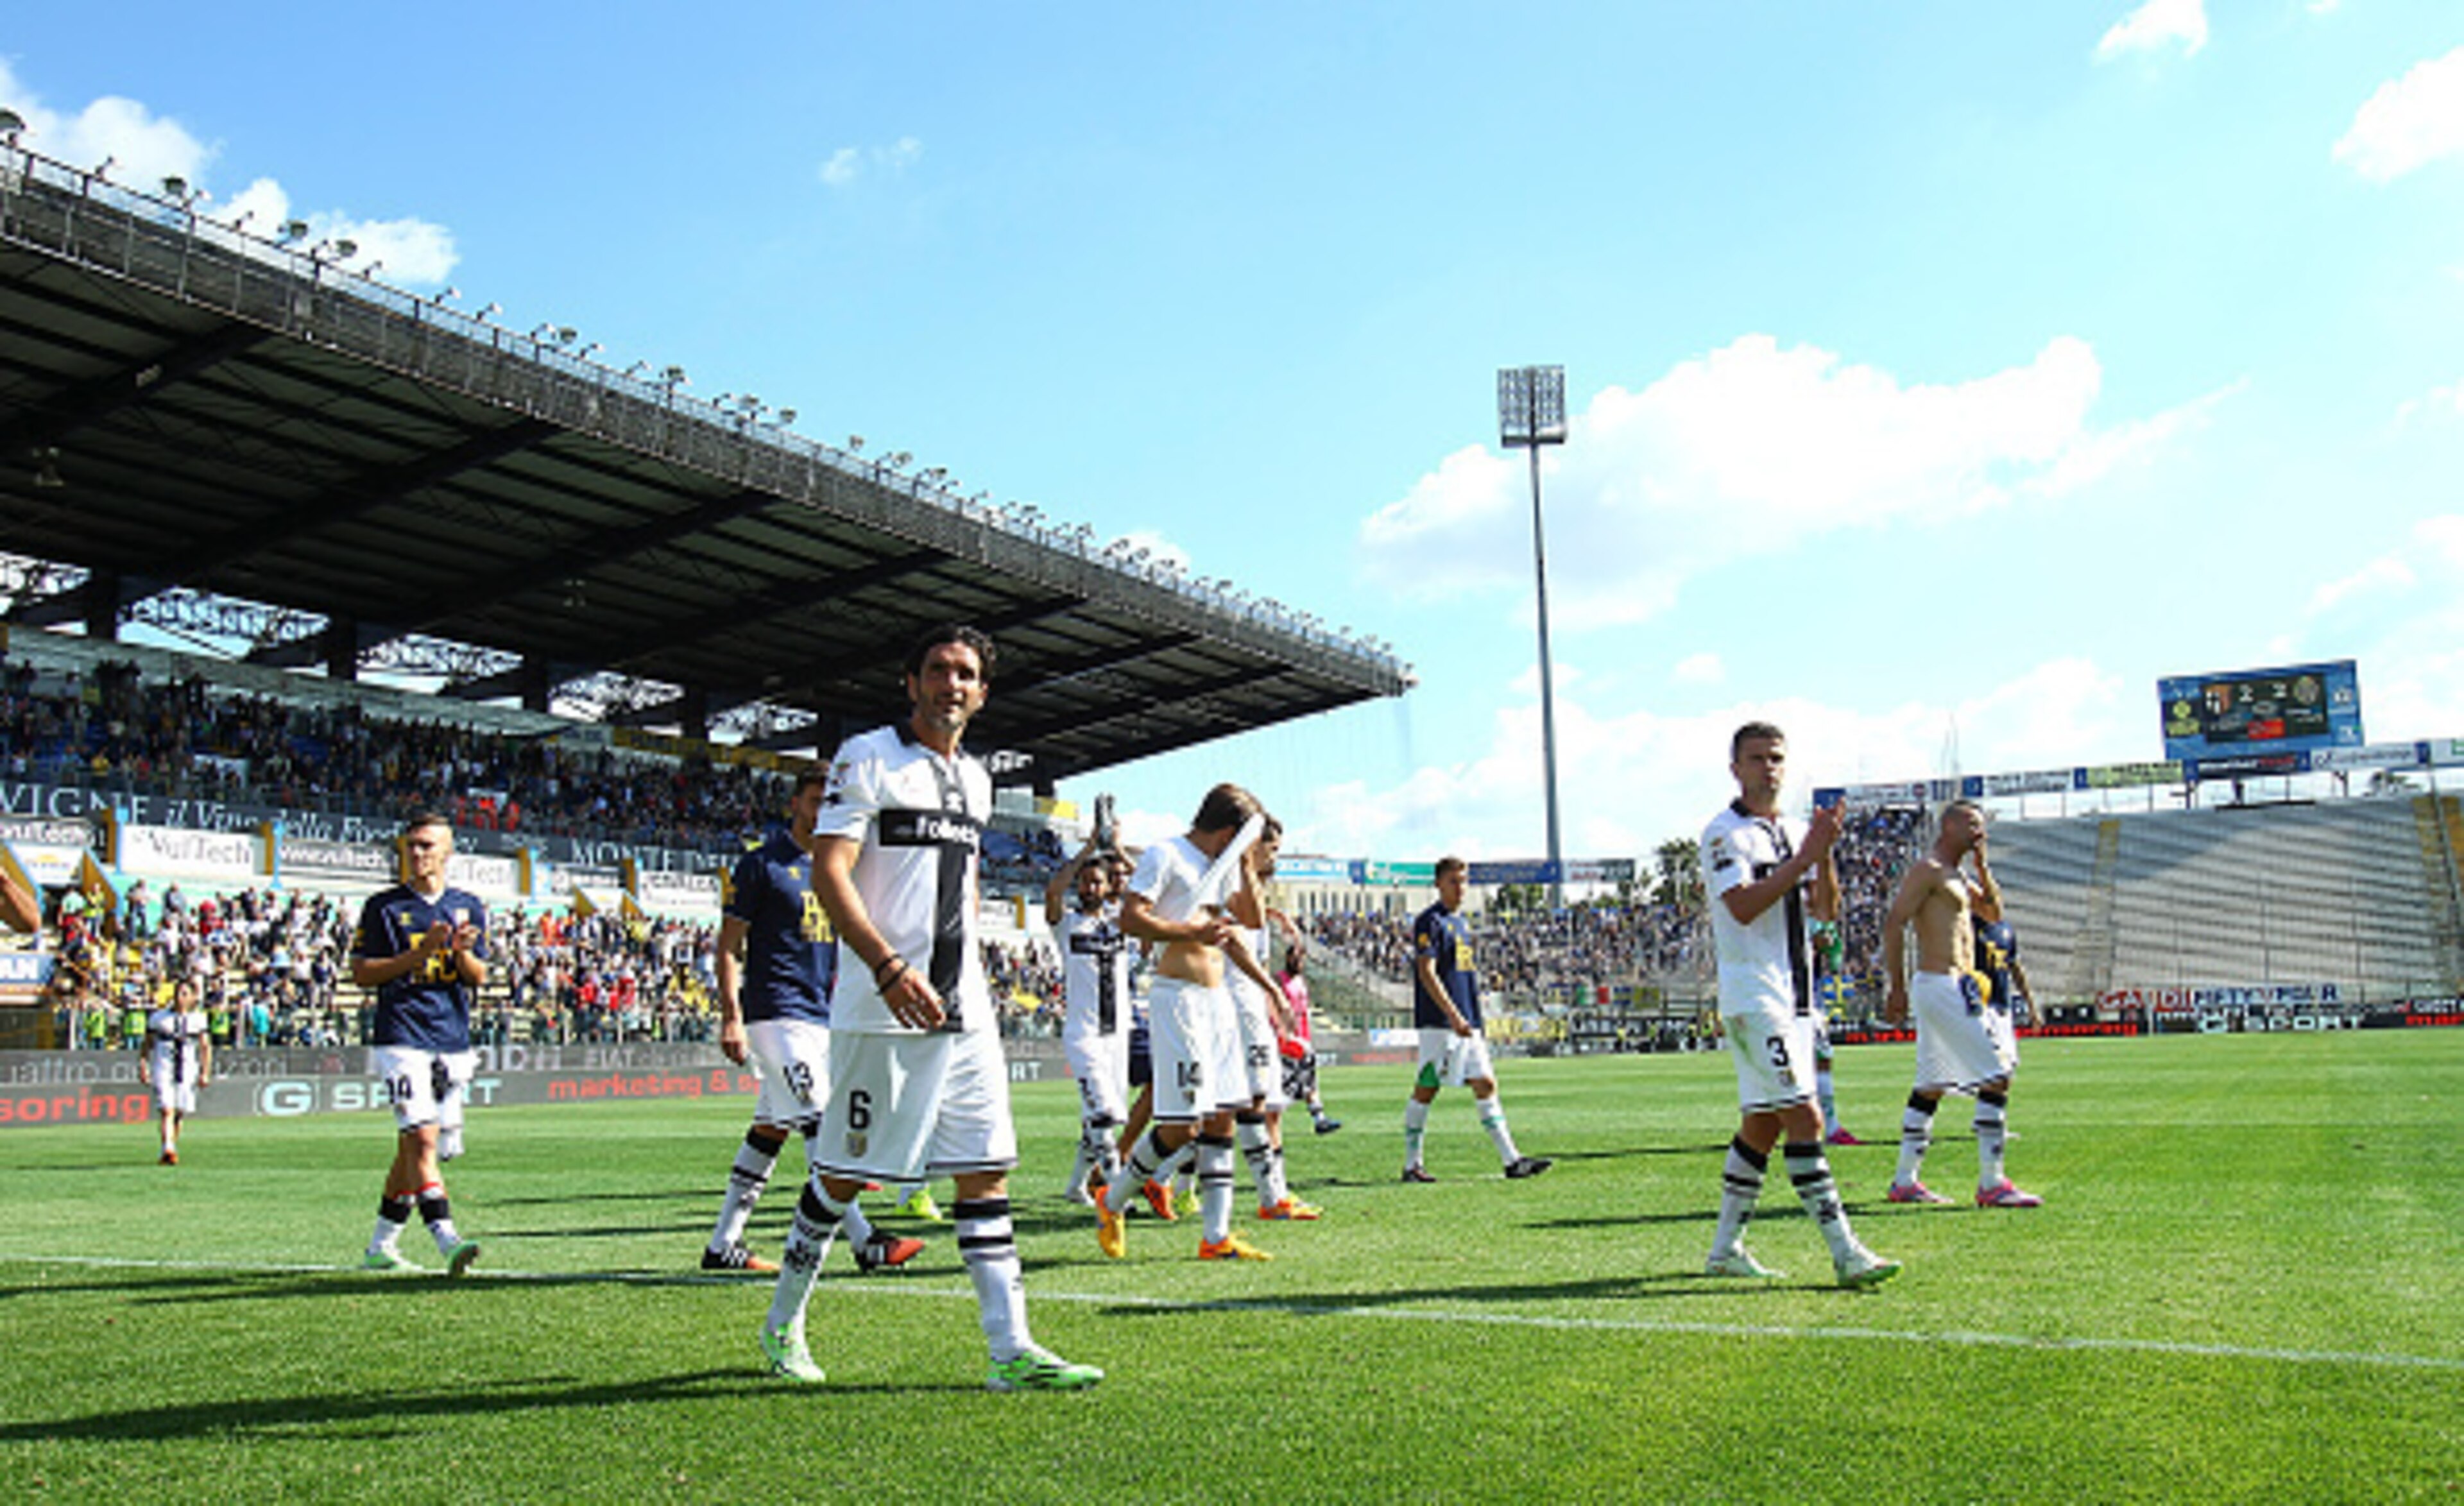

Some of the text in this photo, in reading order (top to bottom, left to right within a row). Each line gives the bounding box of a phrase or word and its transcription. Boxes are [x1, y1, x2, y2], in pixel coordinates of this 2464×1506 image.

[1766, 1035, 1788, 1067] 3
[548, 1070, 703, 1100] marketing
[709, 1070, 730, 1091] &
[783, 1060, 814, 1096] 13
[262, 1078, 502, 1117] G SPT
[849, 1090, 871, 1129] 6
